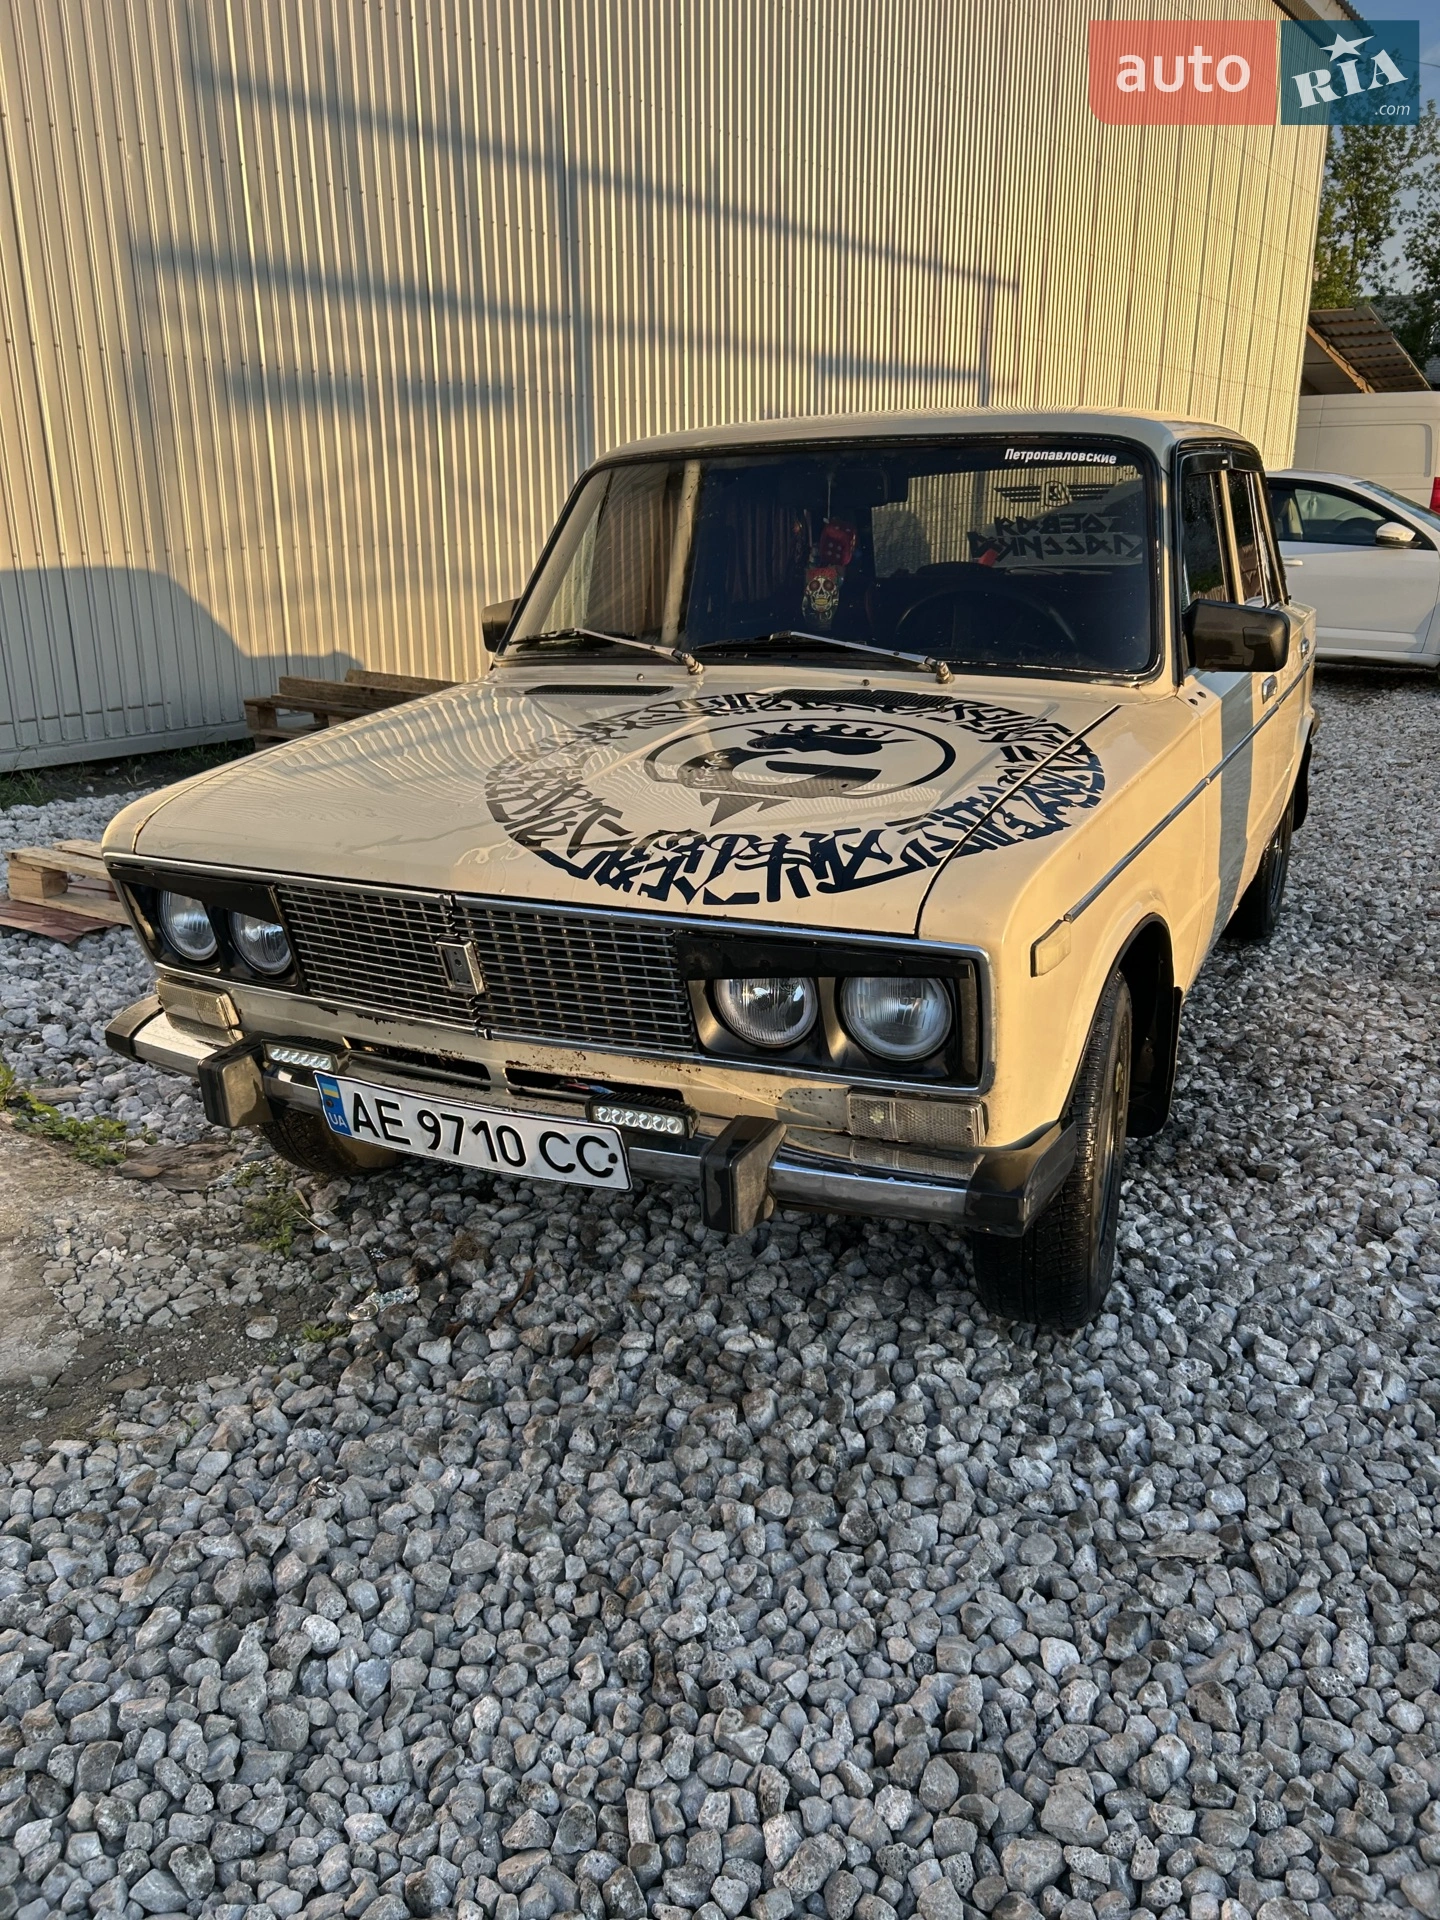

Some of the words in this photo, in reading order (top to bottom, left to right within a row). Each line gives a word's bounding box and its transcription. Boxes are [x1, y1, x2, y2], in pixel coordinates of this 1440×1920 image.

[1004, 448, 1117, 465] Петропавловские
[327, 1112, 348, 1129] UA
[353, 1092, 412, 1146] AE
[416, 1108, 526, 1168] 9710
[538, 1130, 614, 1179] CC
